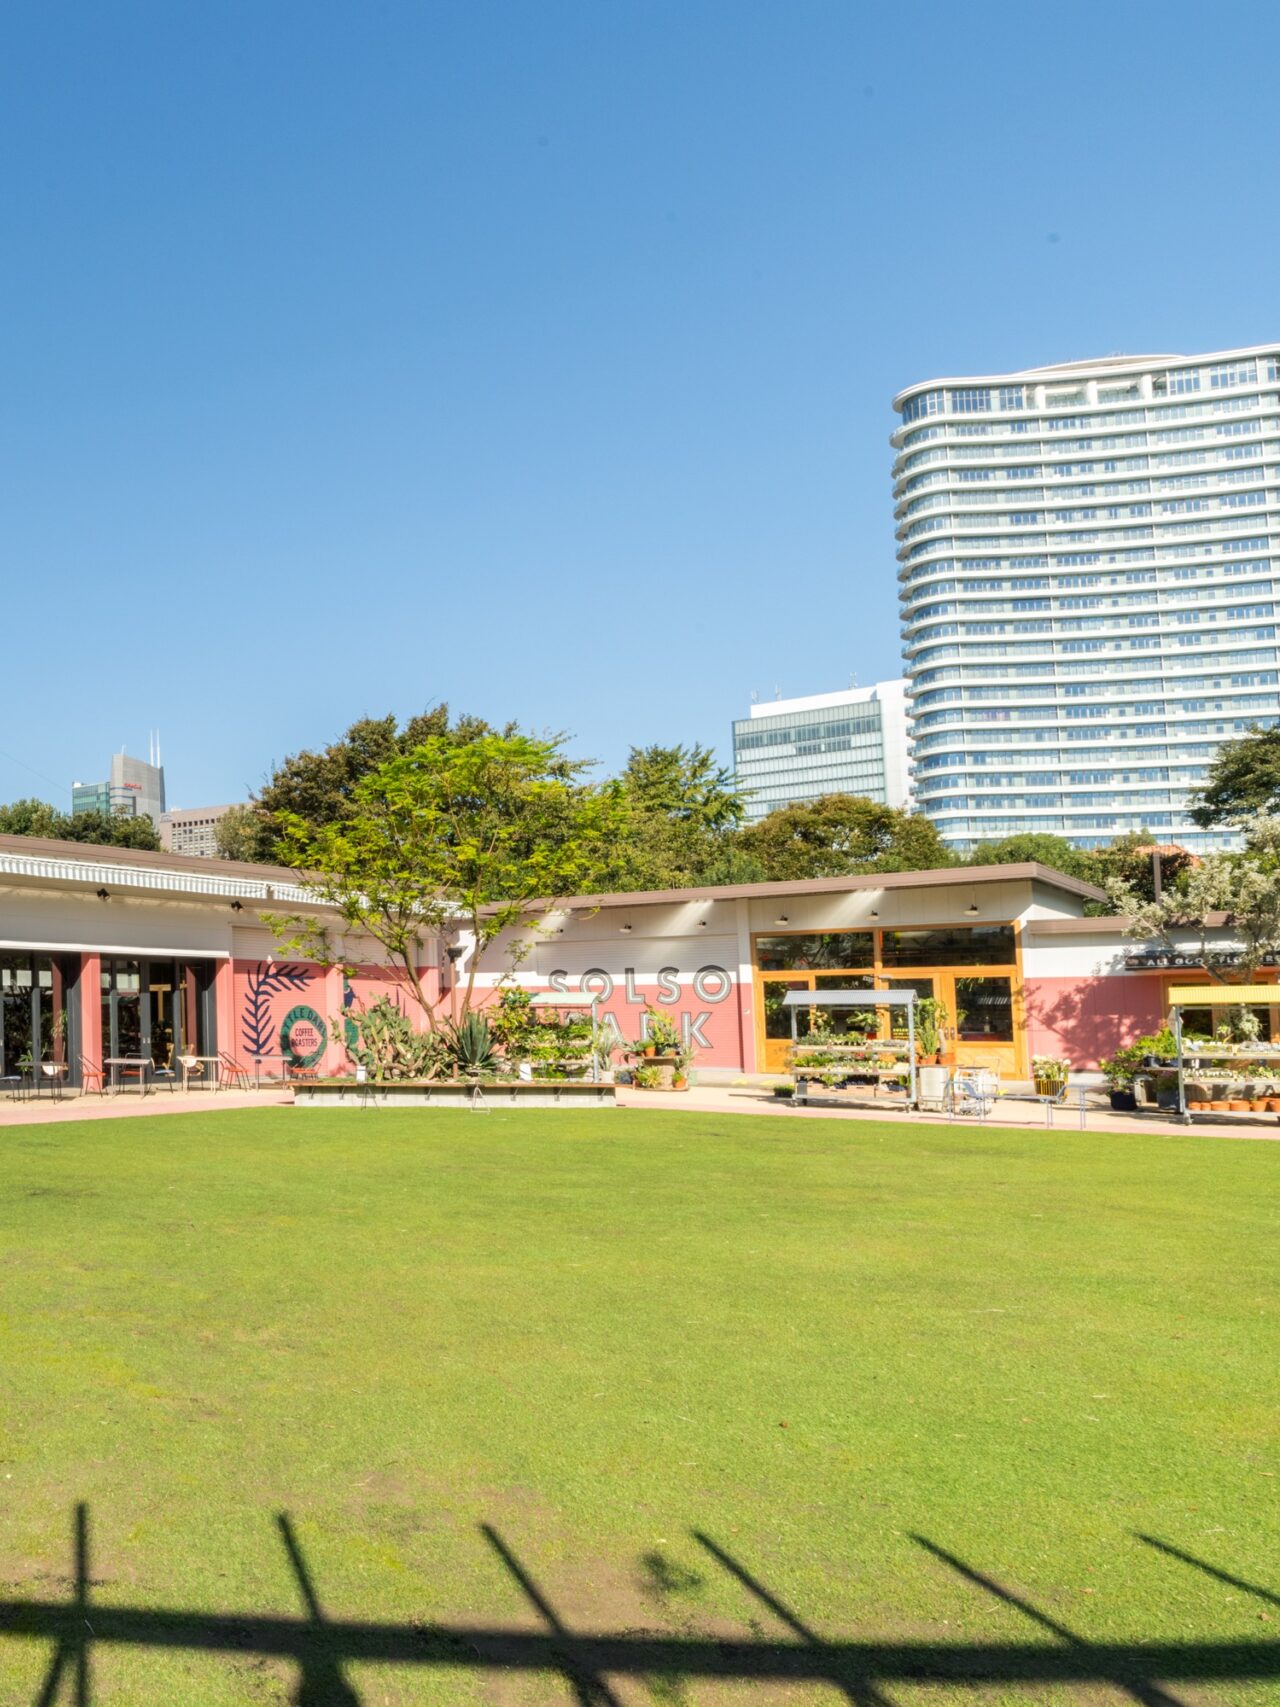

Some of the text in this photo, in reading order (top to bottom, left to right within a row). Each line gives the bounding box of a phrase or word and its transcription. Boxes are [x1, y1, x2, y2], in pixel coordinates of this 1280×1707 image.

[1175, 957, 1213, 965] GOO
[548, 964, 732, 1004] SOLSO
[294, 1028, 314, 1037] COFFEE
[563, 1011, 714, 1049] AK
